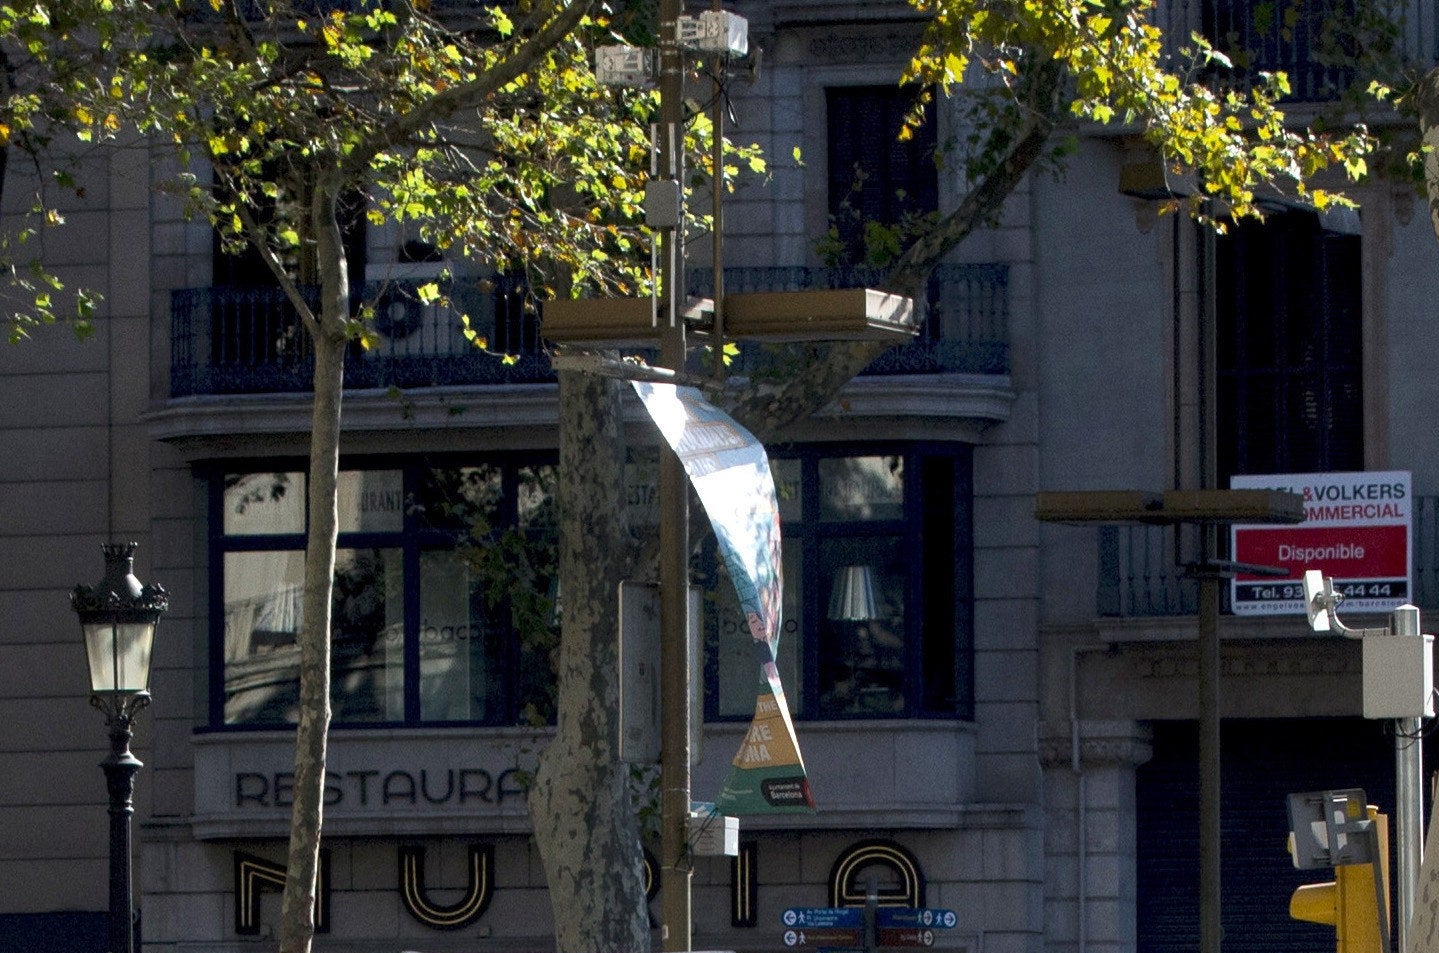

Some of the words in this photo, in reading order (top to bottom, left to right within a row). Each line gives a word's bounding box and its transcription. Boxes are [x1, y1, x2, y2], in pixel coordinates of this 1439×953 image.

[1268, 483, 1406, 502] &VOLKERS
[1302, 503, 1404, 521] OMMERCIAL
[1278, 544, 1365, 563] Disponible
[1252, 586, 1279, 599] Tel.
[1283, 585, 1304, 598] 93
[1344, 584, 1365, 597] 44
[1368, 583, 1391, 597] 44
[235, 769, 530, 808] RESTAURA
